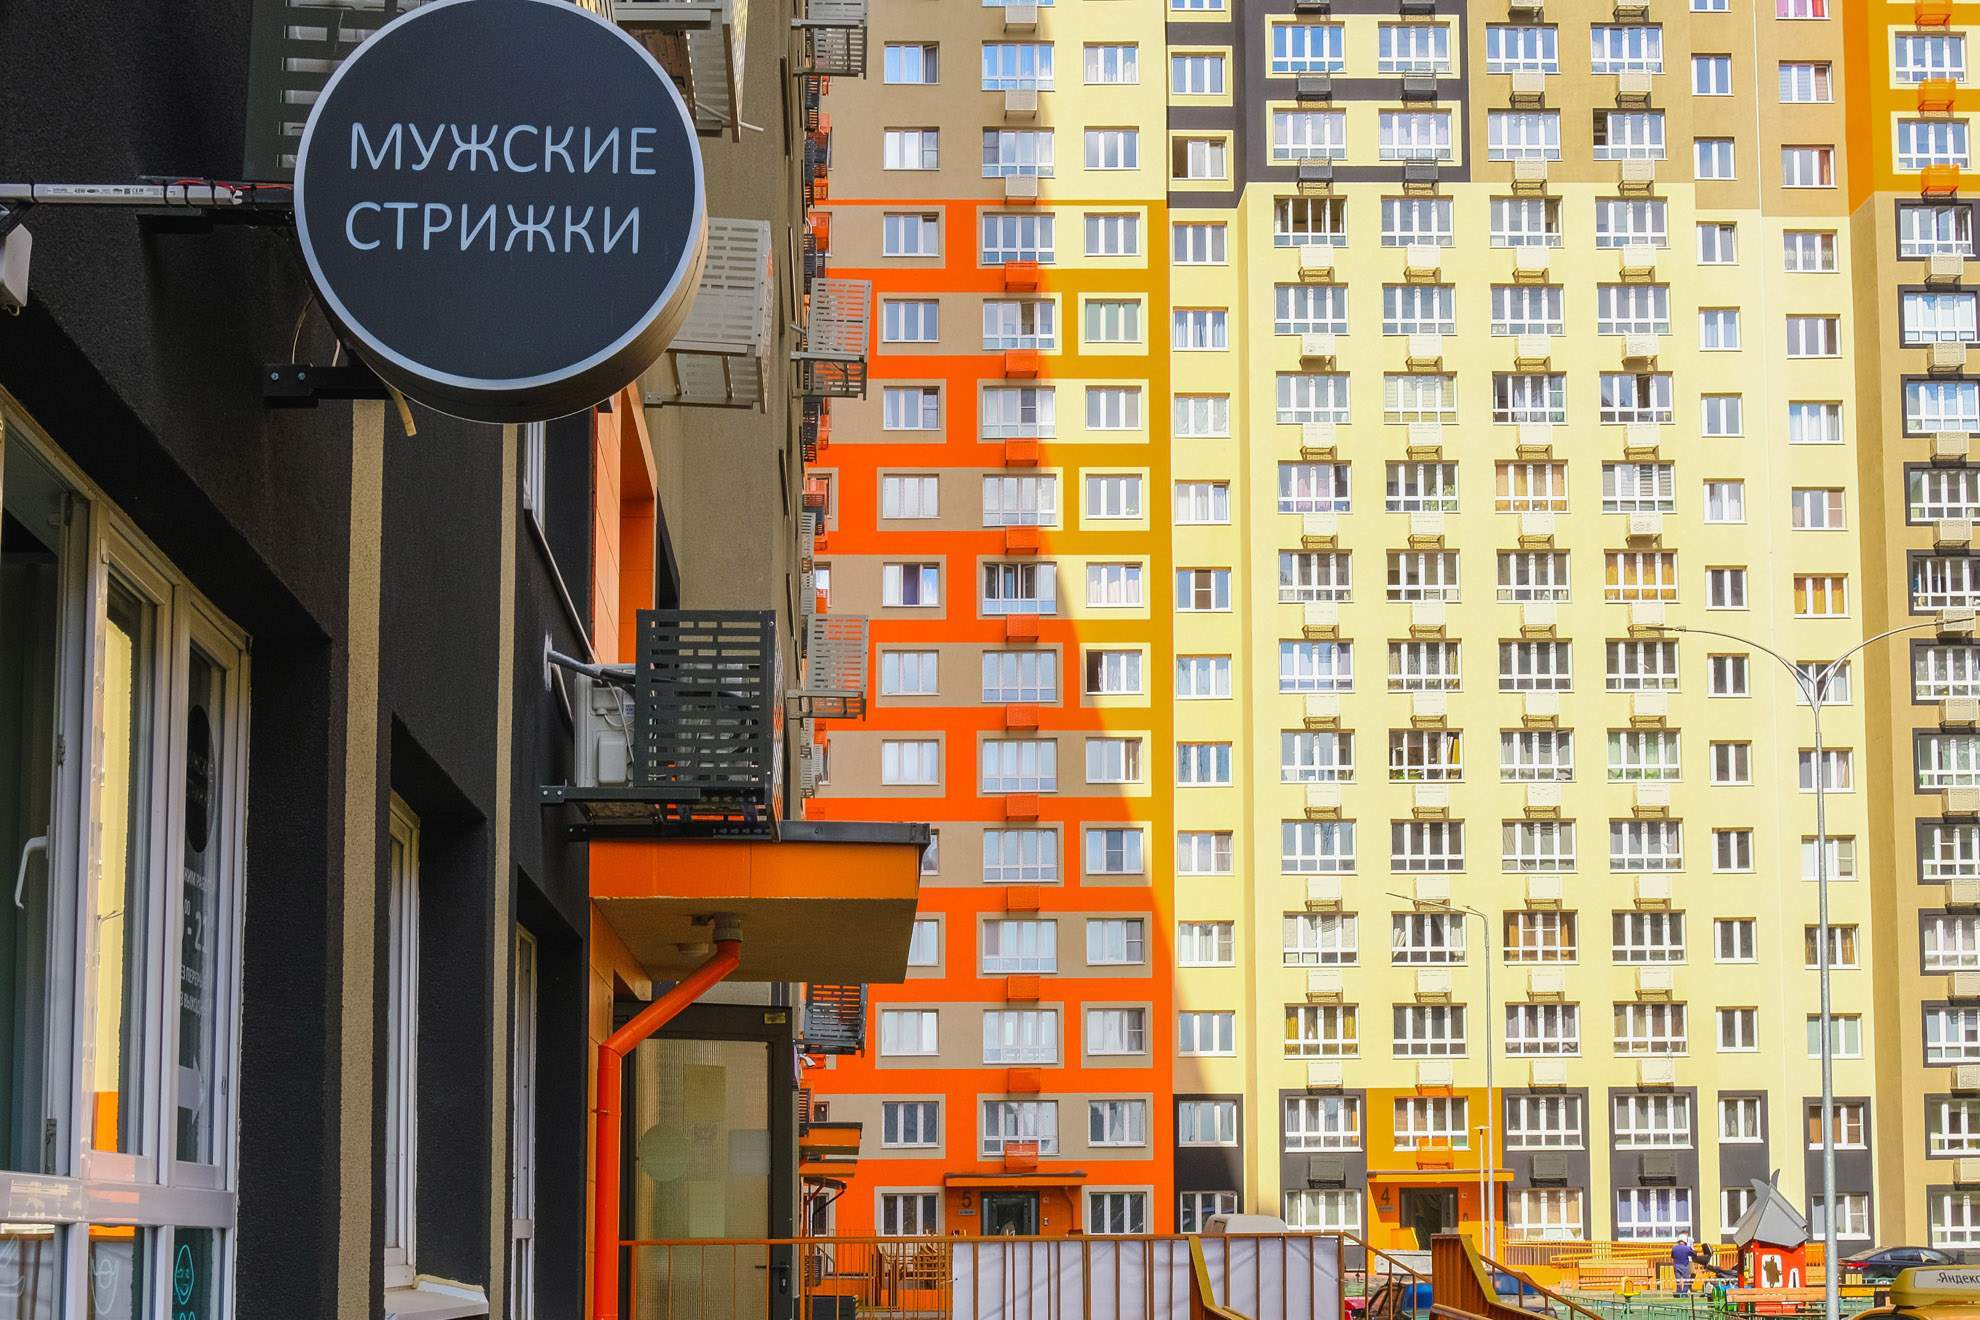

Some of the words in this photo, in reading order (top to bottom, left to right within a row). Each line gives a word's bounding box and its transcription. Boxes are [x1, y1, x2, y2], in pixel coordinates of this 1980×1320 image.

[350, 122, 657, 175] МУЖСКИЕ
[345, 201, 640, 254] СТРИЖКИ
[962, 1190, 972, 1208] 5
[1381, 1186, 1390, 1204] 4
